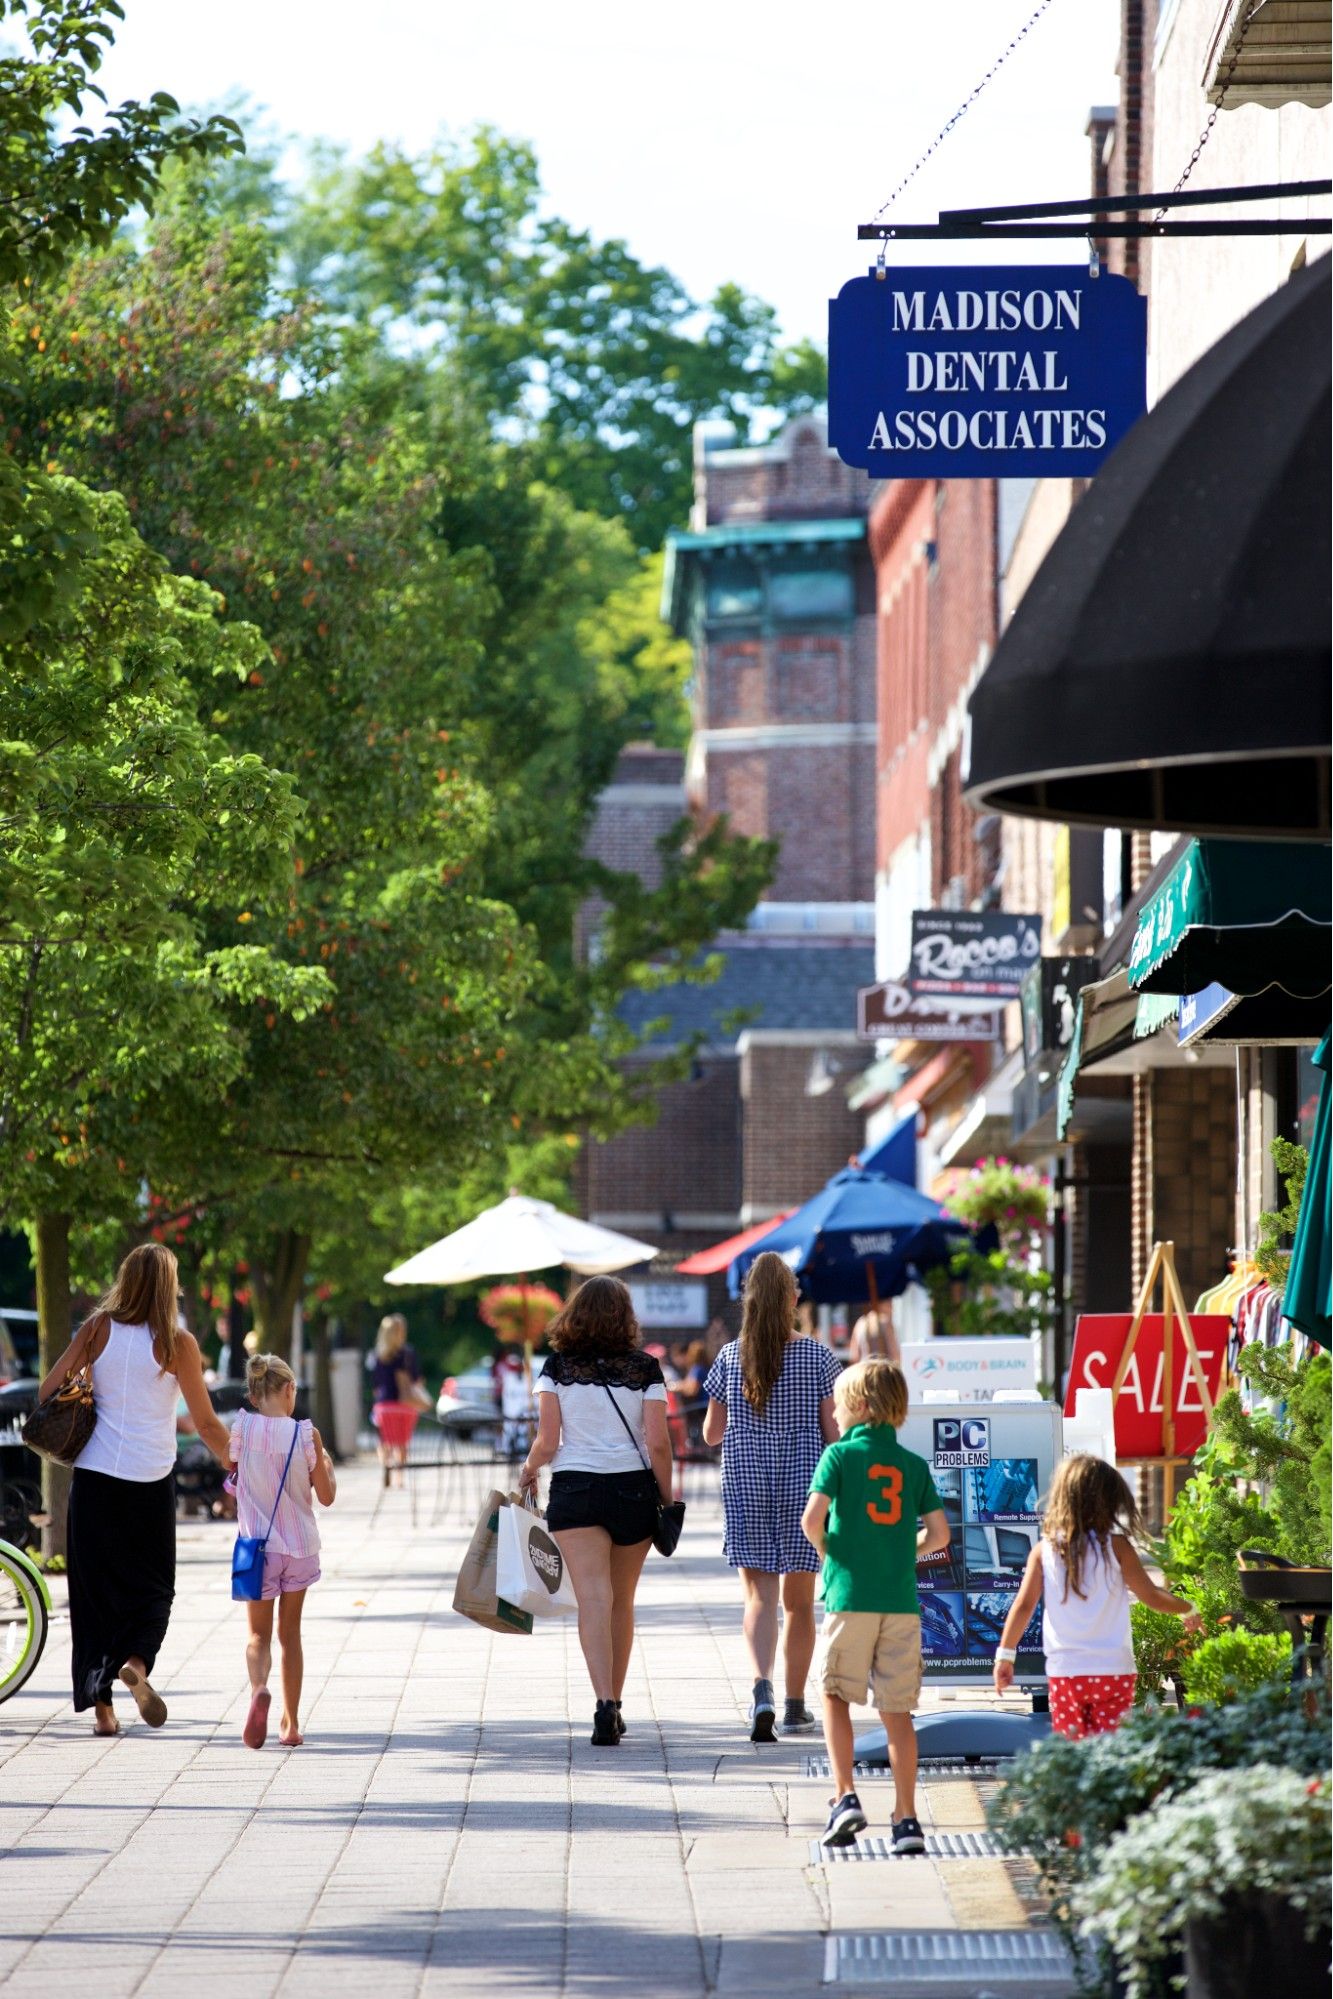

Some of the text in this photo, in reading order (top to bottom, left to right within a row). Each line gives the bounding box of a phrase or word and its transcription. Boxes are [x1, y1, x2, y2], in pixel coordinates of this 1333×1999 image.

[891, 290, 1082, 331] MADISON
[905, 351, 1068, 392] DENTAL
[867, 410, 1106, 450] ASSOCIATES
[913, 918, 1040, 980] Rocco's
[1083, 1351, 1214, 1413] SALE
[938, 1421, 987, 1450] PC
[936, 1453, 989, 1466] PROBLEMS
[867, 1463, 903, 1525] 3
[993, 1513, 1018, 1521] Remote
[993, 1580, 1020, 1589] Carry-In
